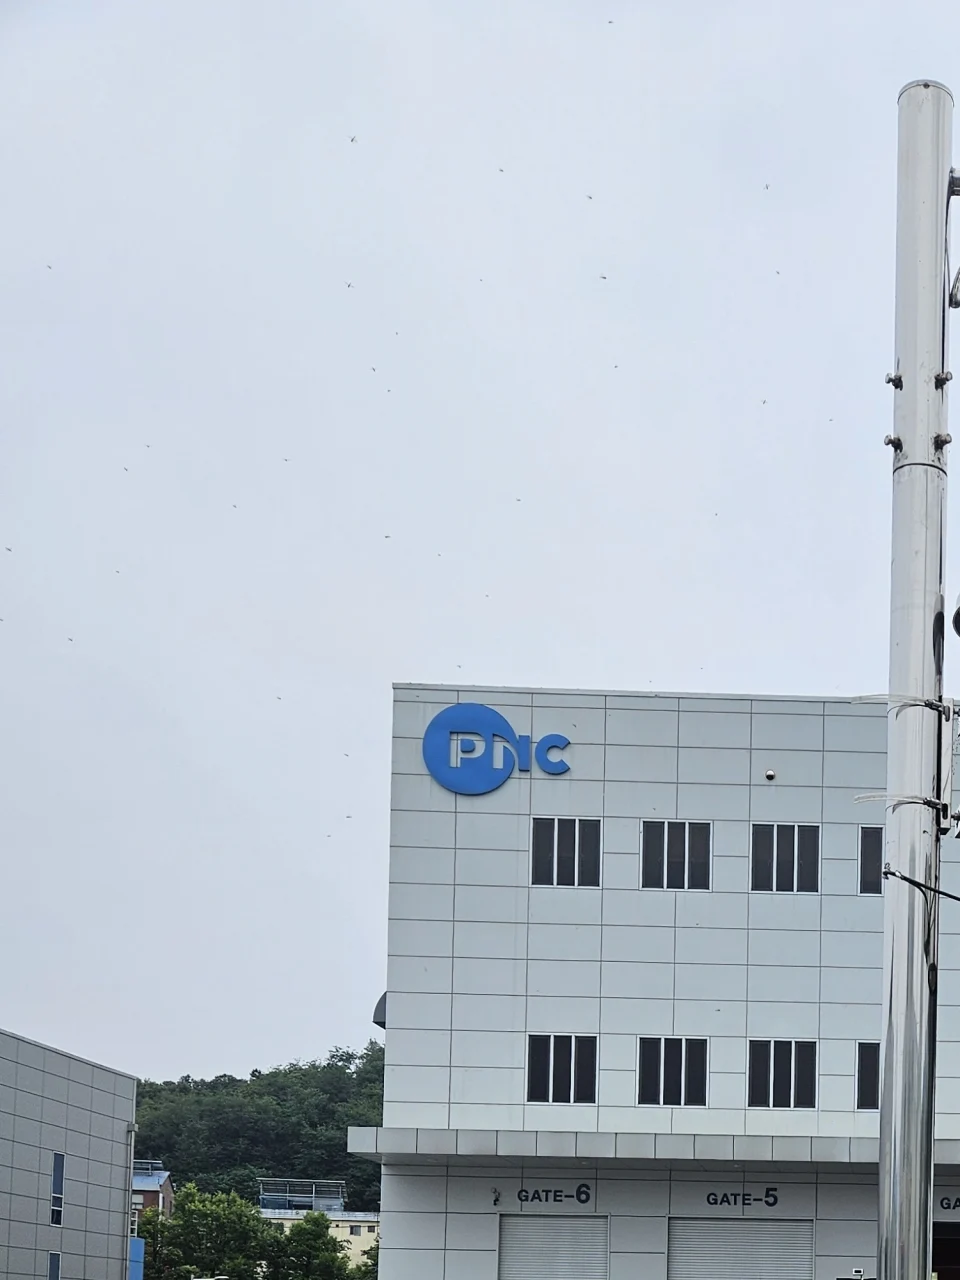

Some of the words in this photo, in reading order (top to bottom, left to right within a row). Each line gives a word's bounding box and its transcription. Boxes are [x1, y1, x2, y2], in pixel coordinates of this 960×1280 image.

[449, 731, 571, 775] PNC
[517, 1183, 591, 1204] GATE-6
[706, 1187, 779, 1207] GATE-5
